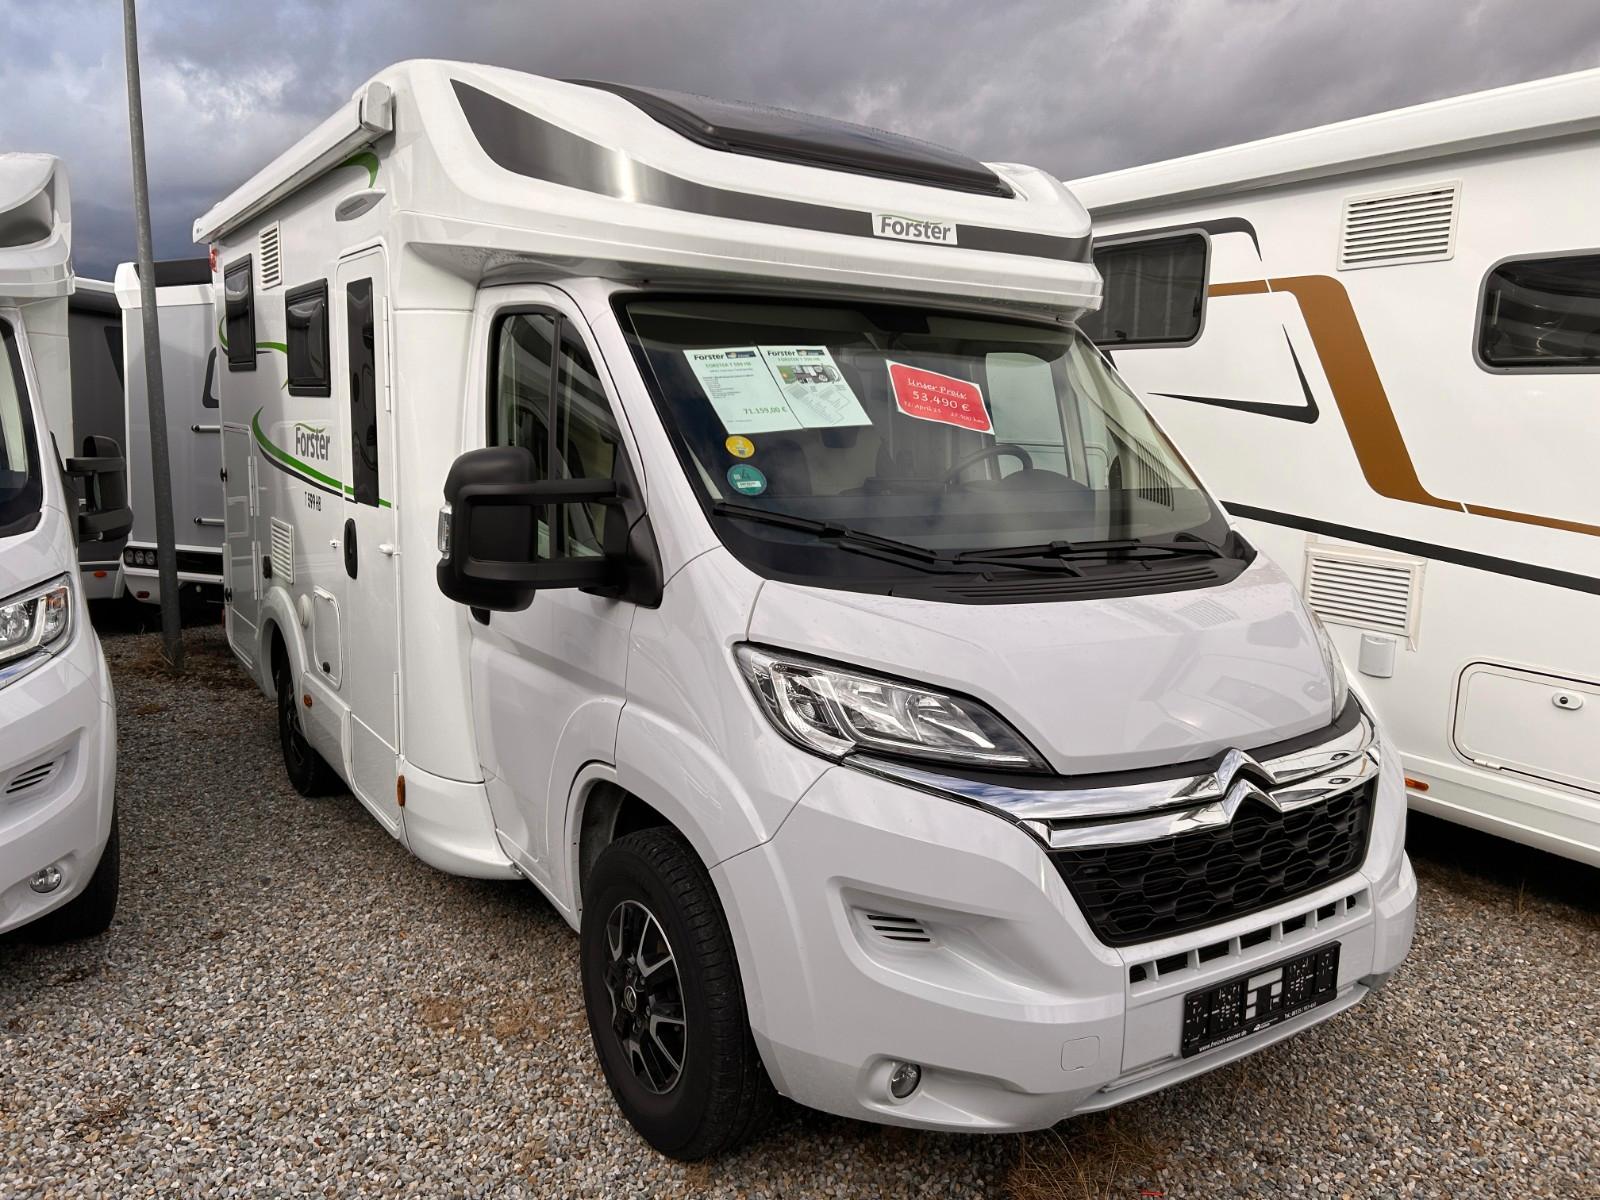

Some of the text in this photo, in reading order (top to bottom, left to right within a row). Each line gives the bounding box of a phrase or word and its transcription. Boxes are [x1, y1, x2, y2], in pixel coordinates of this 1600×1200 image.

[881, 216, 951, 240] Forster
[913, 391, 970, 411] 53.490 €
[295, 427, 330, 461] Forster
[316, 496, 321, 511] HB
